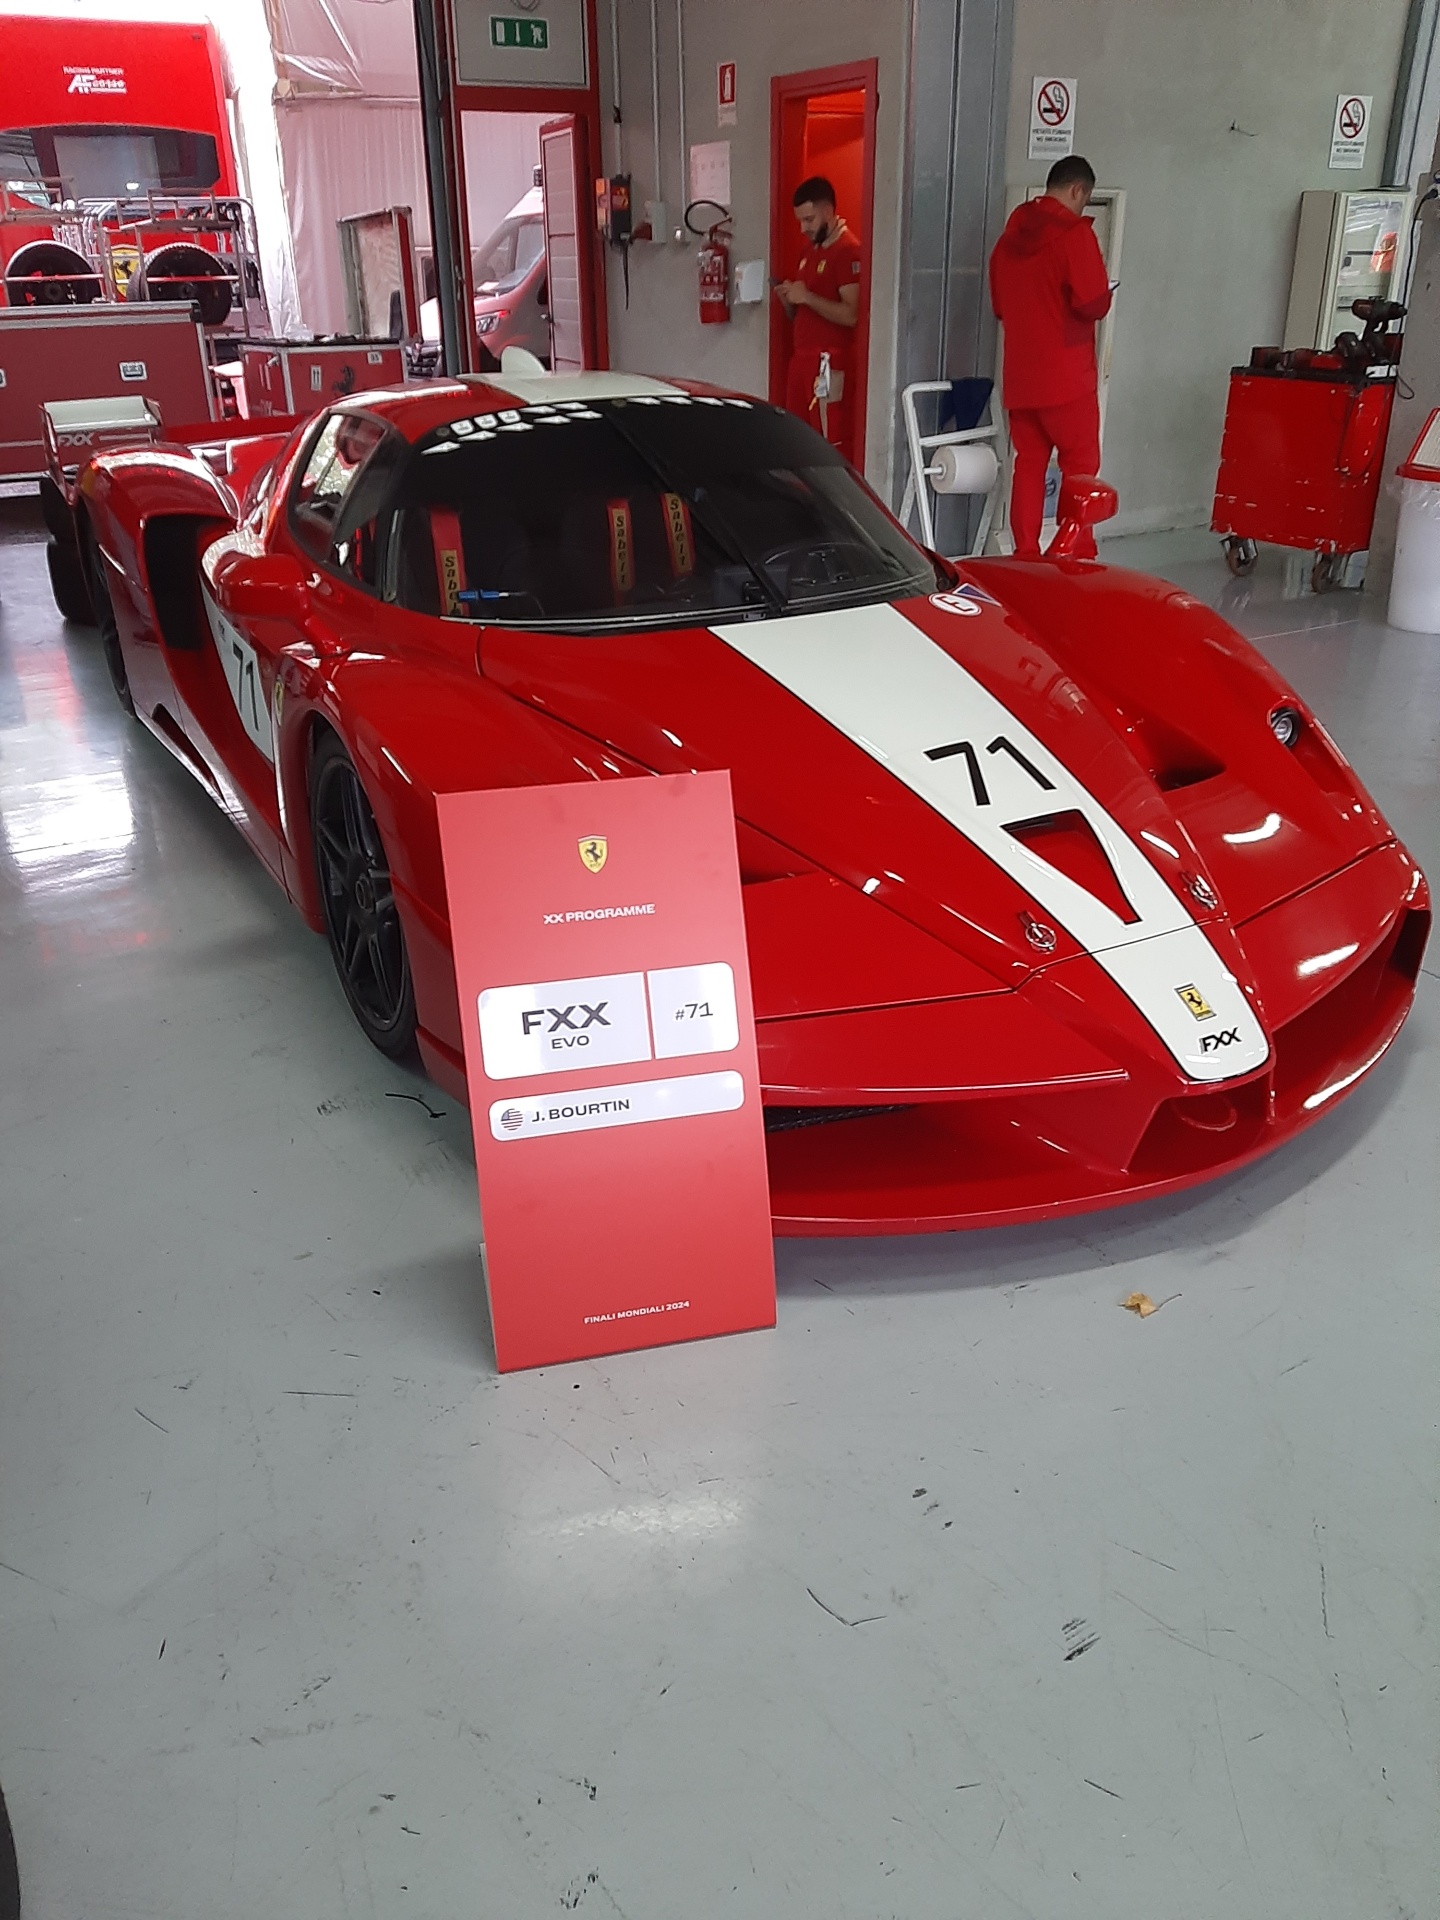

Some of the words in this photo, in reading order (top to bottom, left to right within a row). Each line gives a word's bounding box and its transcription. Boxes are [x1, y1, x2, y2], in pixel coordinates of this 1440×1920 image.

[445, 556, 459, 611] Sabel
[232, 640, 259, 732] 71
[923, 736, 1057, 806] 71
[543, 913, 564, 925] XX
[565, 903, 656, 922] PROGRAMME
[521, 1002, 611, 1035] FXX
[675, 1002, 714, 1020] #71
[551, 1035, 590, 1049] EVO
[1200, 1027, 1242, 1054] FXX
[531, 1110, 546, 1122] J.
[549, 1099, 630, 1120] BOURTIN
[584, 1313, 616, 1324] FINALI
[617, 1305, 665, 1319] MONDIALI
[666, 1300, 690, 1311] 2024
